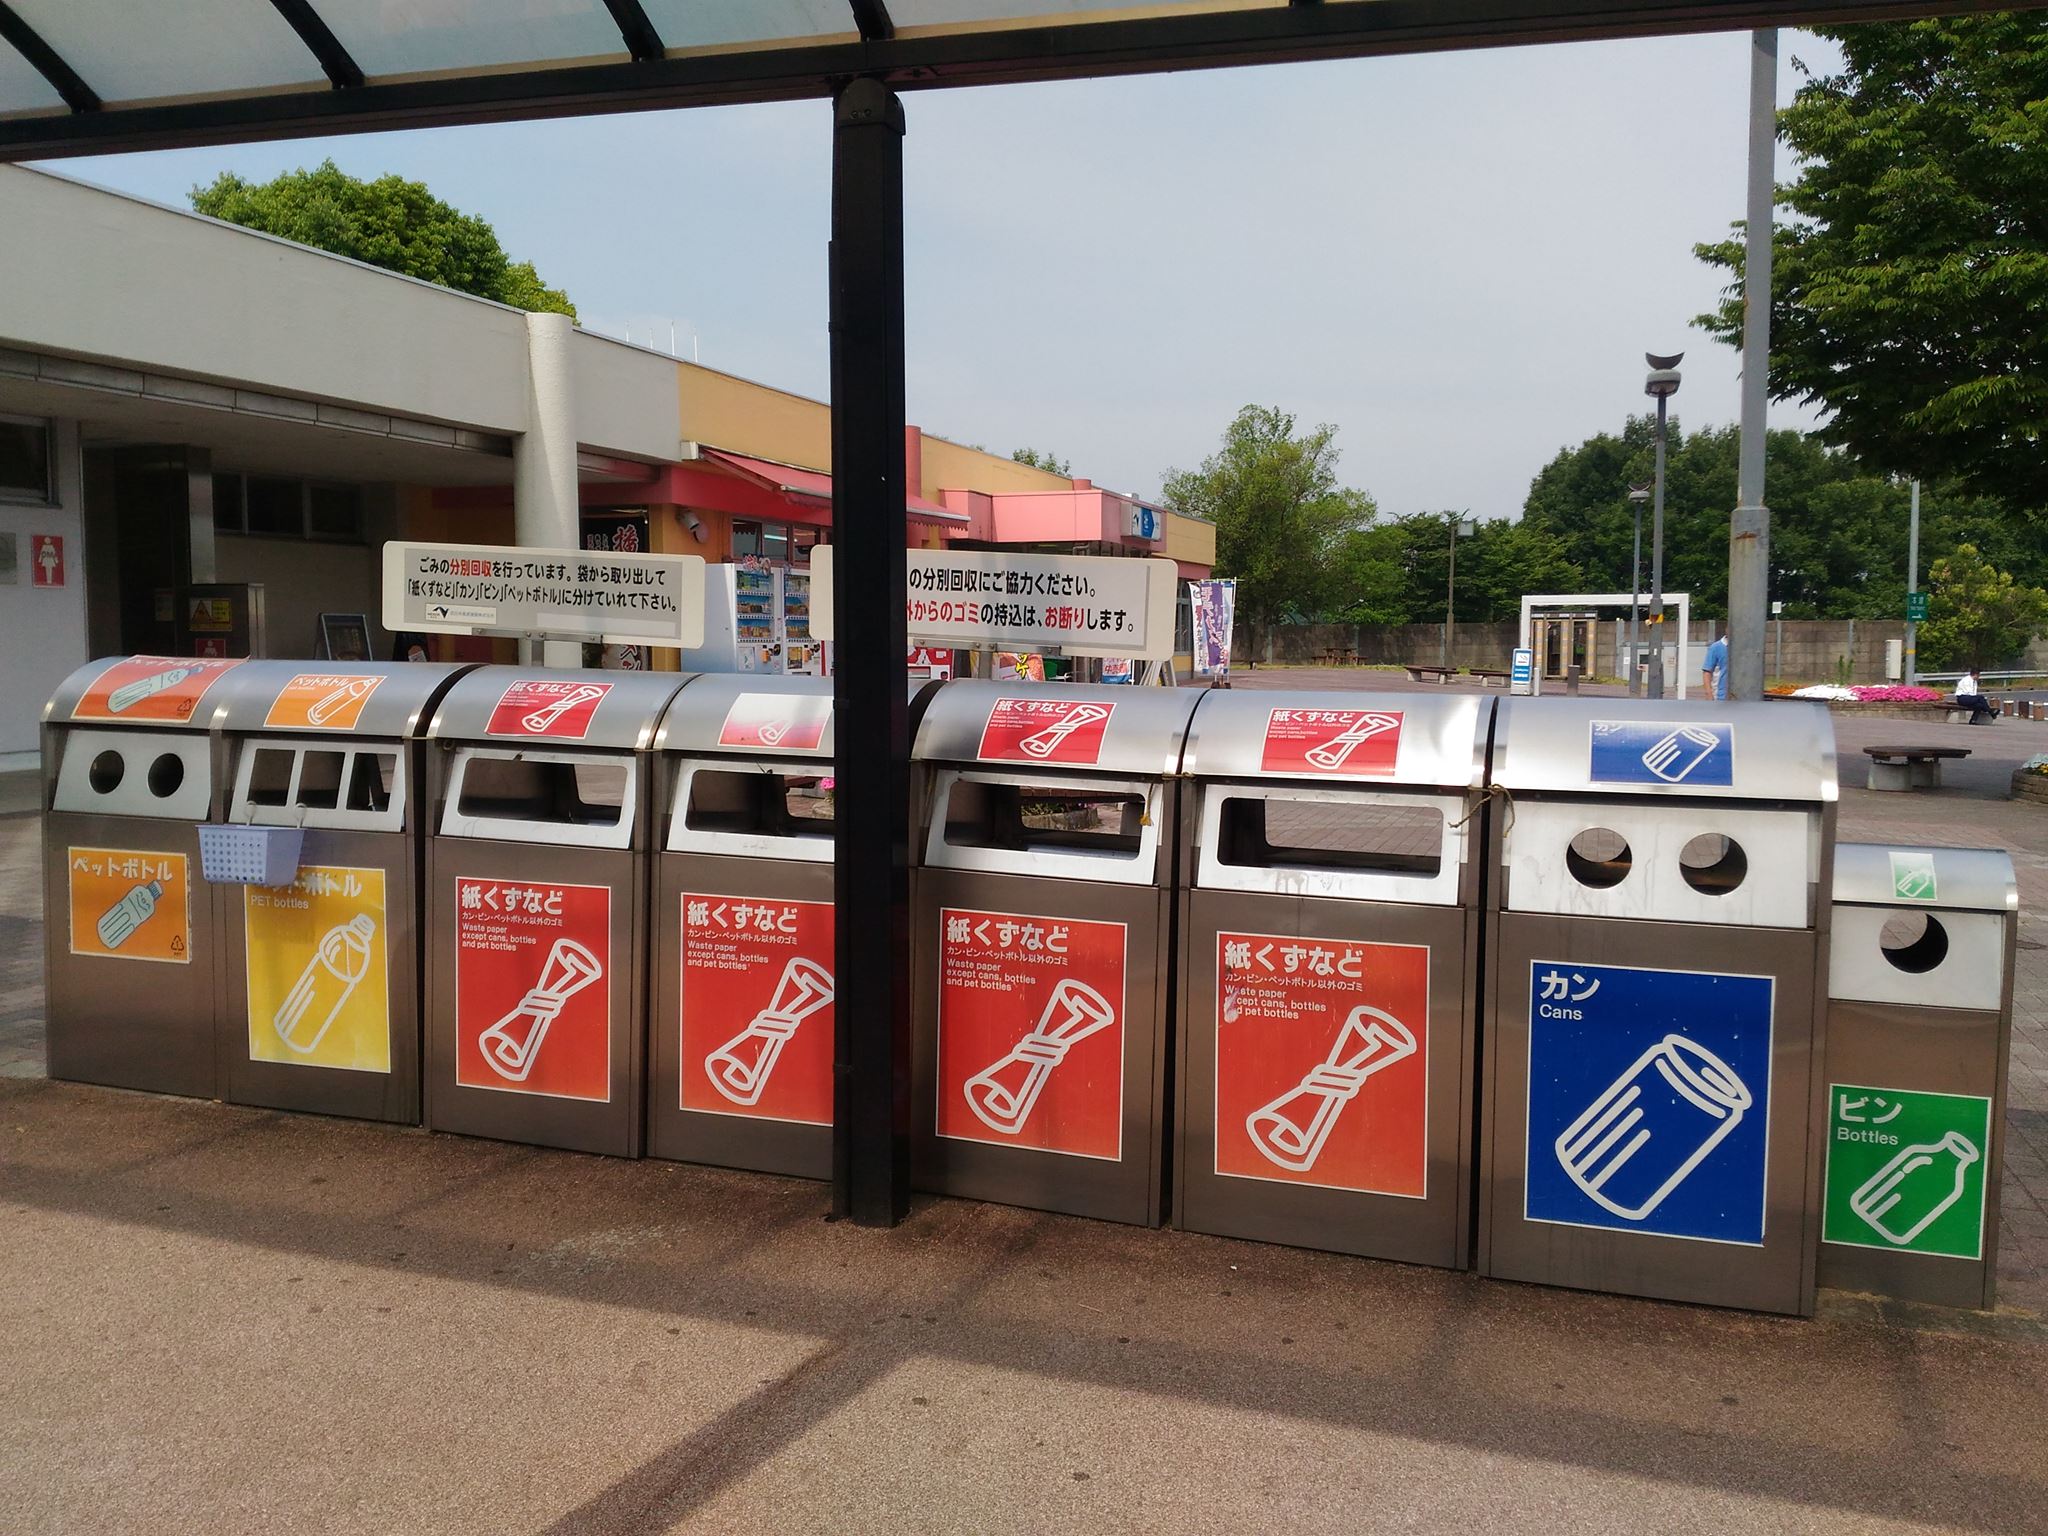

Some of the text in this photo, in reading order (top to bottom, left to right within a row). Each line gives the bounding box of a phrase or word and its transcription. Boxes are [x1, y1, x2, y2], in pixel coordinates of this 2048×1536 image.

[294, 677, 349, 687] ペットボトル
[511, 682, 577, 694] 紙くずなど
[997, 700, 1072, 714] 紙くずなど
[1272, 711, 1355, 724] 紙くずなど
[73, 857, 173, 881] ペットボトル
[250, 895, 309, 910] PET bottles
[462, 884, 563, 915] 紙くずなど
[687, 900, 798, 933] 紙くずなど
[462, 923, 508, 934] Waste paper
[947, 916, 1069, 953] 紙くずなど
[462, 932, 487, 942] except
[510, 935, 537, 945] bottles
[462, 940, 517, 951] and pet bottles
[687, 940, 737, 952] Waste paper
[687, 950, 715, 961] except
[740, 951, 769, 963] bottles
[1225, 940, 1364, 978] 紙くずなど
[687, 958, 747, 971] and pet bottles
[947, 958, 1002, 972] Waste paper
[947, 968, 976, 980] except
[1004, 972, 1036, 984] bottles
[947, 977, 1012, 991] and pet bottles
[1540, 970, 1600, 1001] カン
[1258, 988, 1287, 999] paper
[1225, 996, 1258, 1008] cept
[1291, 1000, 1327, 1012] bottles
[1245, 1007, 1261, 1017] pet
[1264, 1006, 1299, 1019] bottles
[1539, 1004, 1583, 1021] Cans
[1839, 1094, 1902, 1124] ビン
[1837, 1126, 1898, 1145] Bottles
